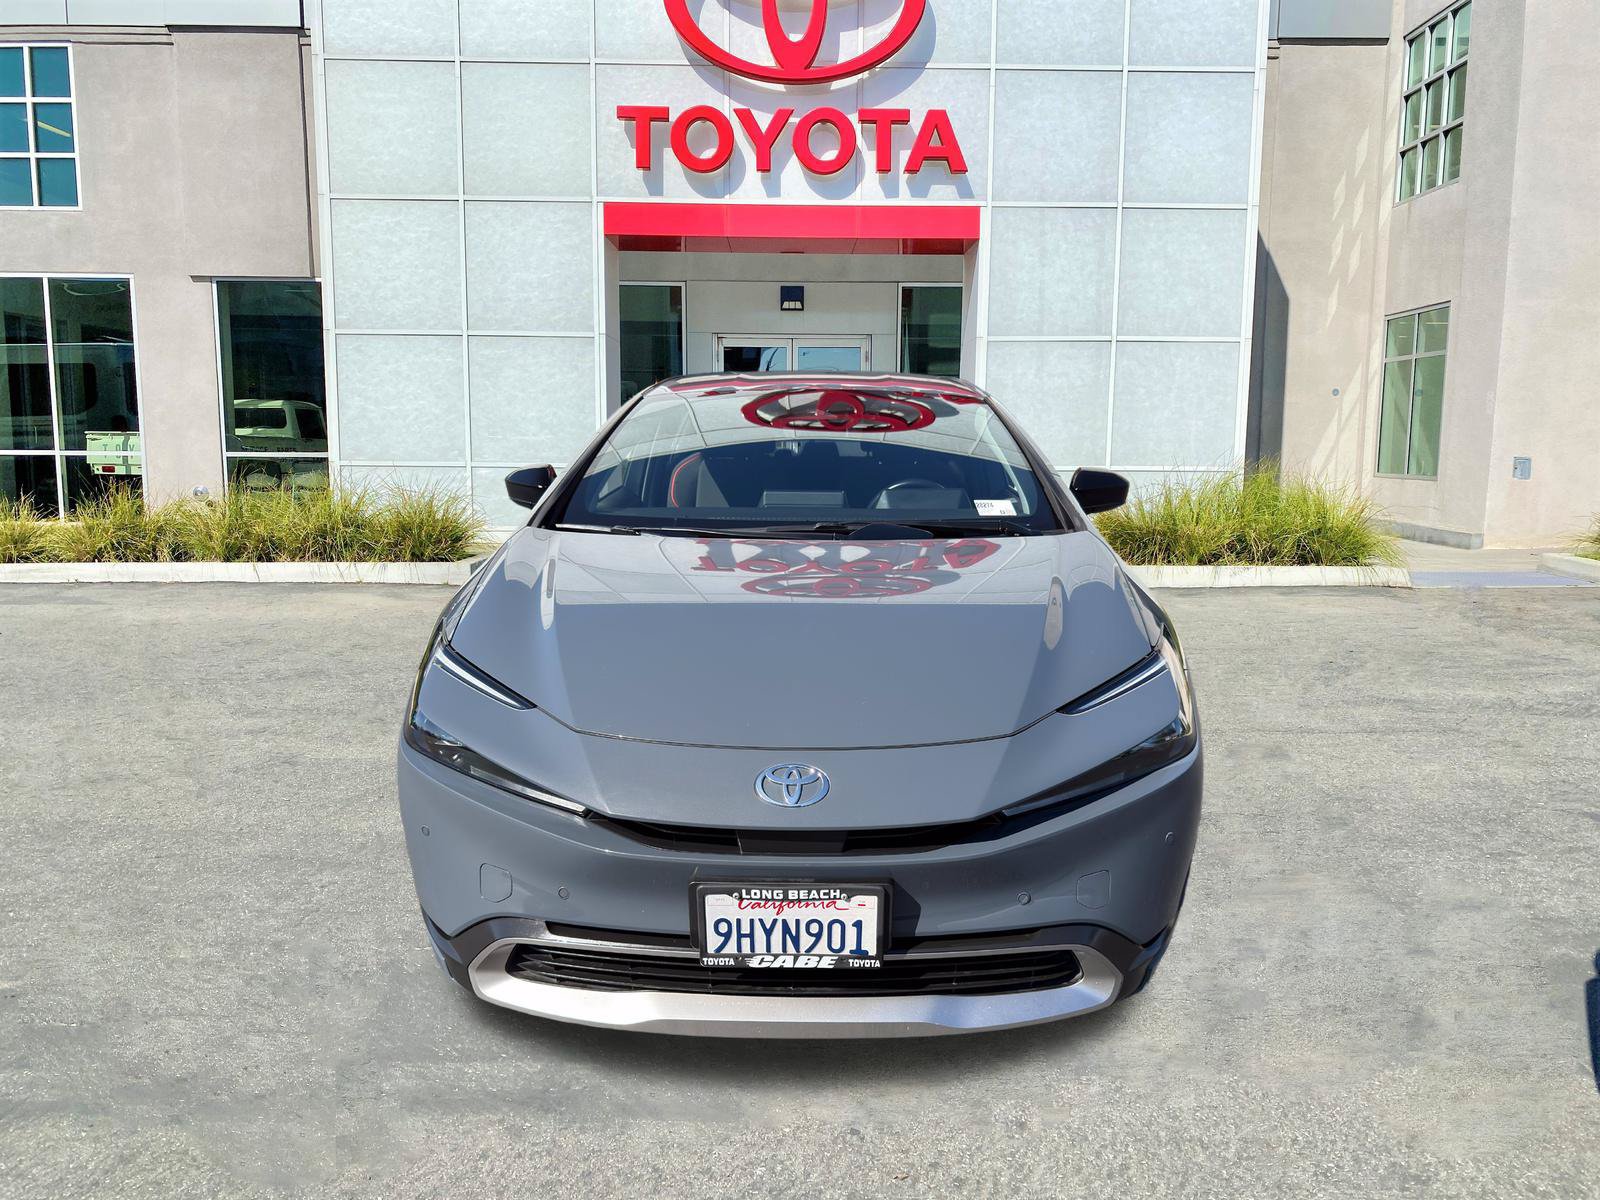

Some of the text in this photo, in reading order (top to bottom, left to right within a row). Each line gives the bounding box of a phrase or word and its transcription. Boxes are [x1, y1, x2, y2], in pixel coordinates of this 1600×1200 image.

[616, 104, 969, 175] TOYOTA
[741, 889, 841, 900] LONG BEACH
[738, 898, 850, 916] California
[713, 918, 869, 956] 9HYN901
[702, 955, 881, 968] TOYOTA CABE TOYOTA
